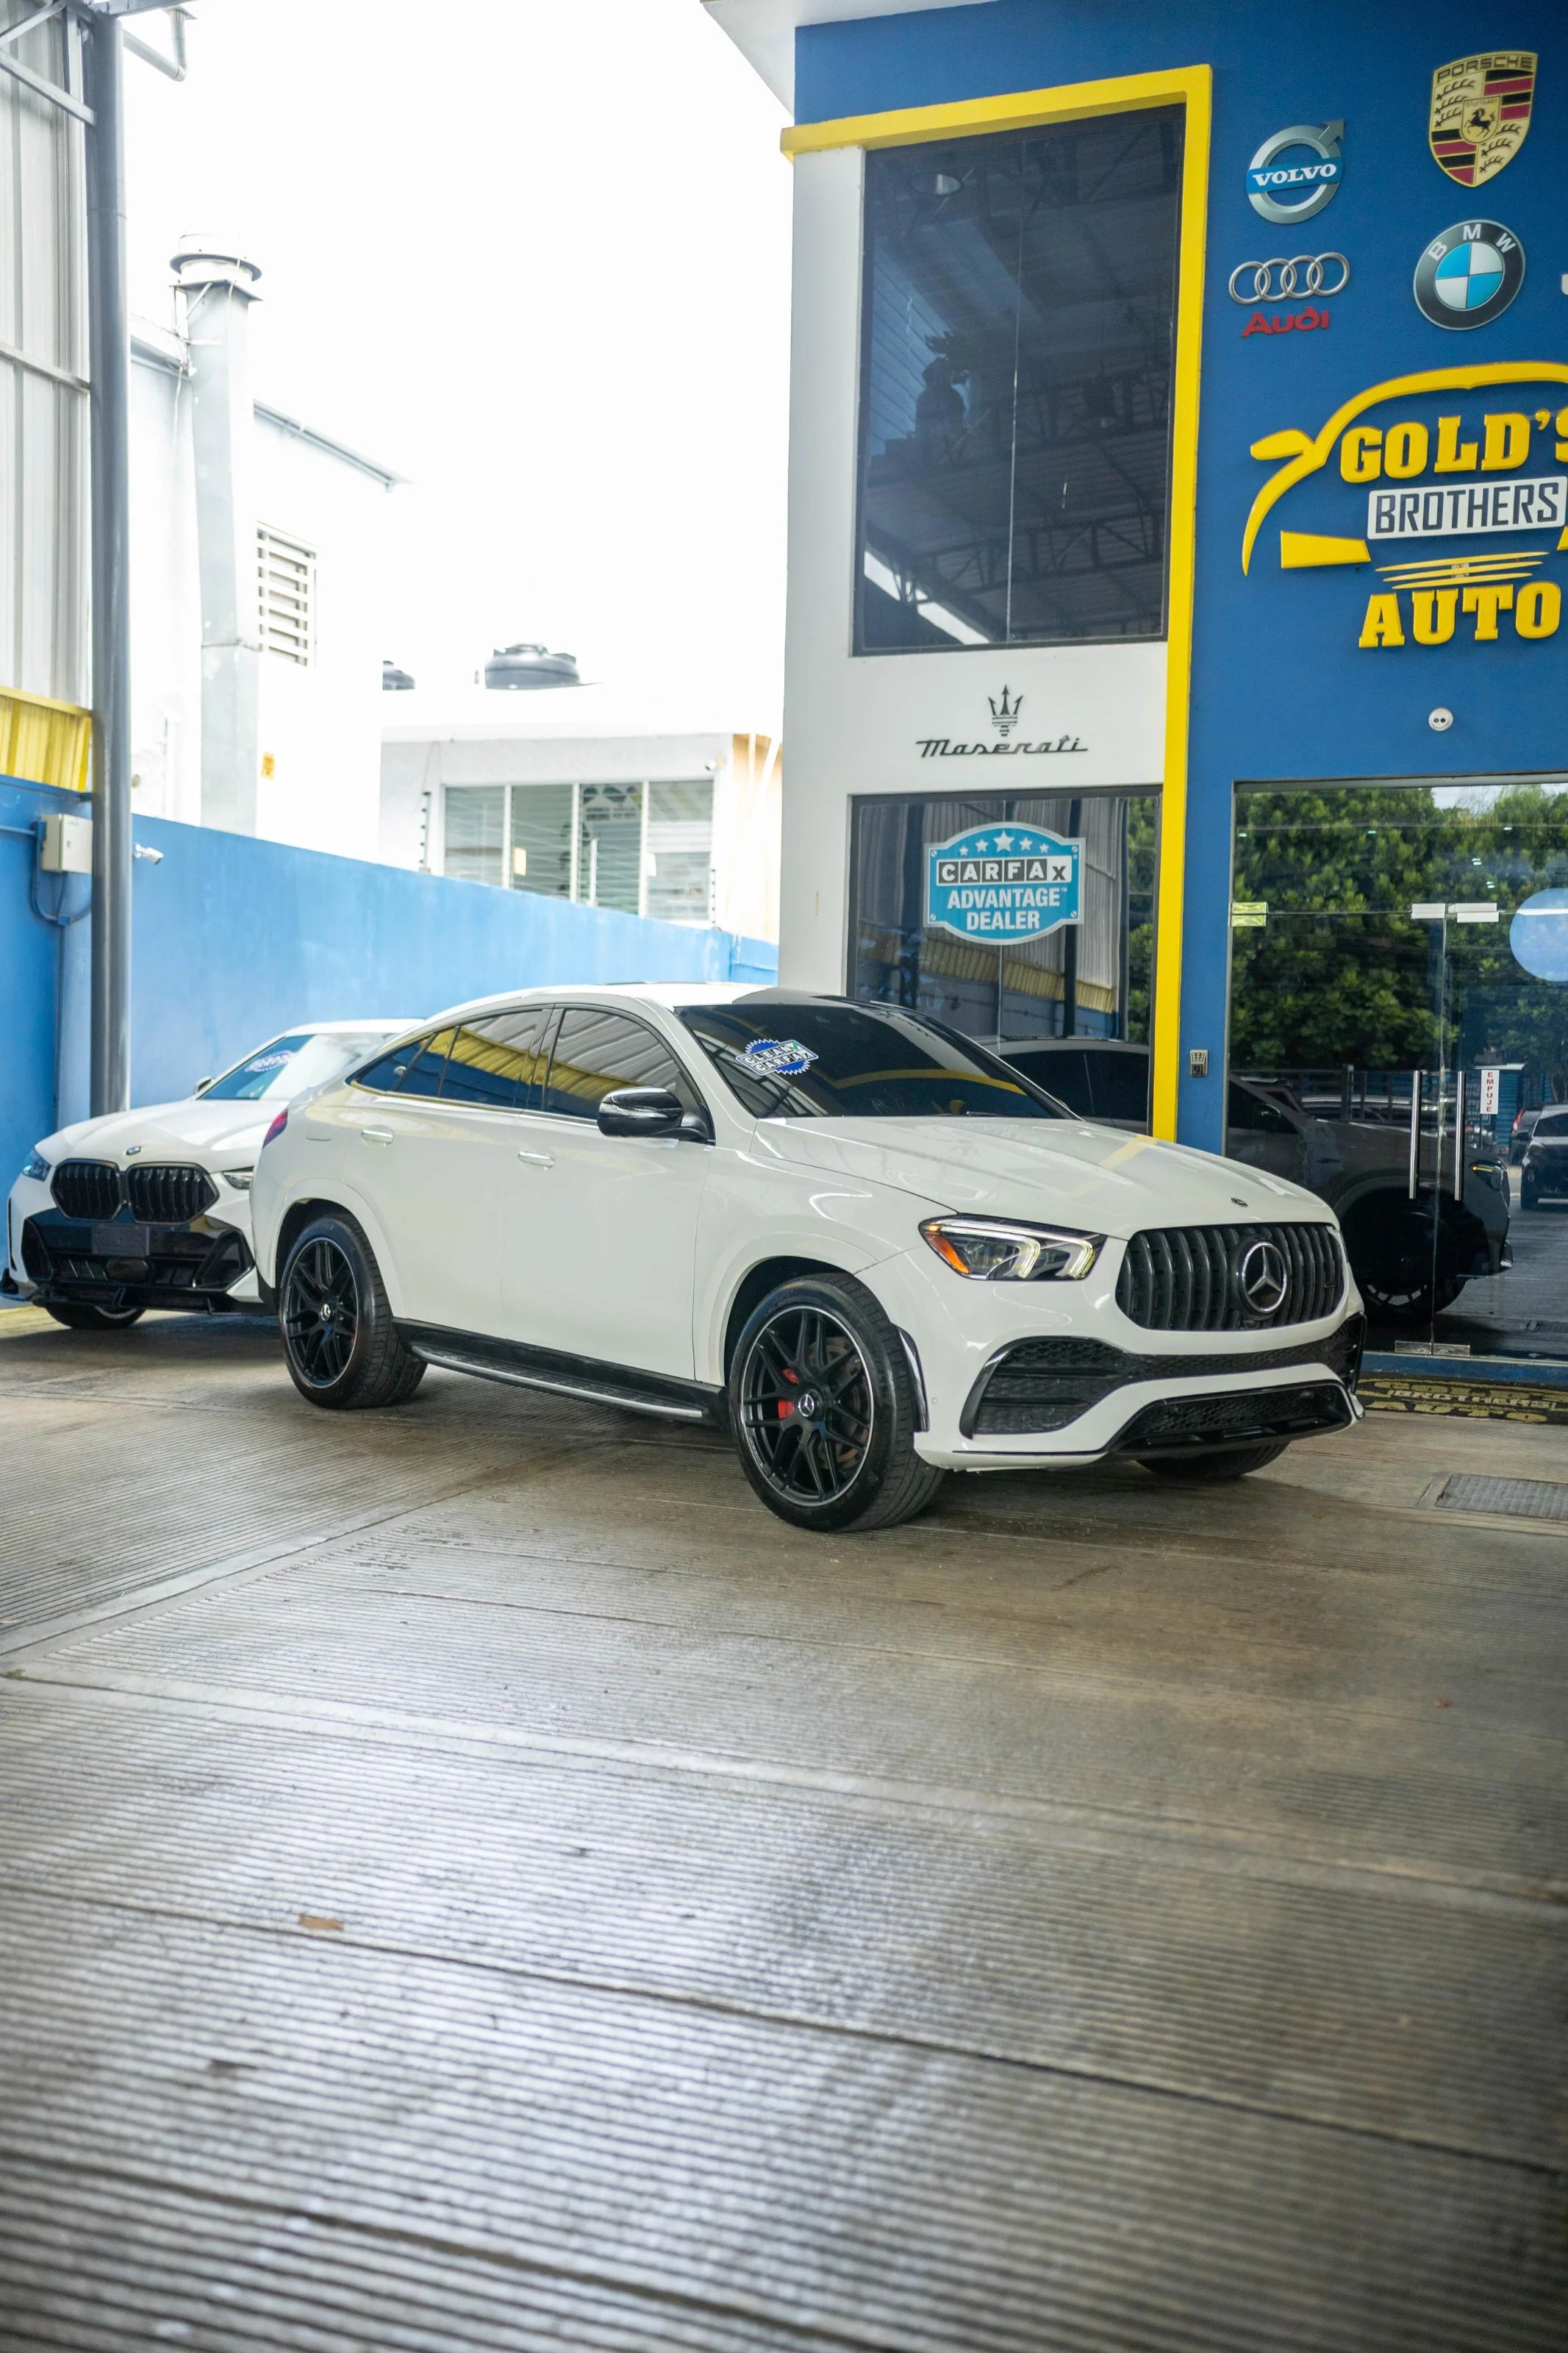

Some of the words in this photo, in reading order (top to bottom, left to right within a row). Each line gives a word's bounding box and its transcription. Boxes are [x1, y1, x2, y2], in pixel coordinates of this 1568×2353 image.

[1437, 56, 1533, 85] PORSCHE
[1252, 163, 1337, 187] VOLVO
[1428, 224, 1517, 261] BMW
[1241, 306, 1329, 338] Audi
[1340, 406, 1568, 484] GOLD'
[1375, 482, 1559, 534] BROTHERS
[1358, 581, 1561, 649] AUTO
[915, 735, 1089, 758] Maserati
[941, 861, 1067, 882] CARFAX
[967, 911, 1040, 931] DEALER
[744, 1044, 791, 1064] CLEAN
[755, 1051, 810, 1072] CARFAX
